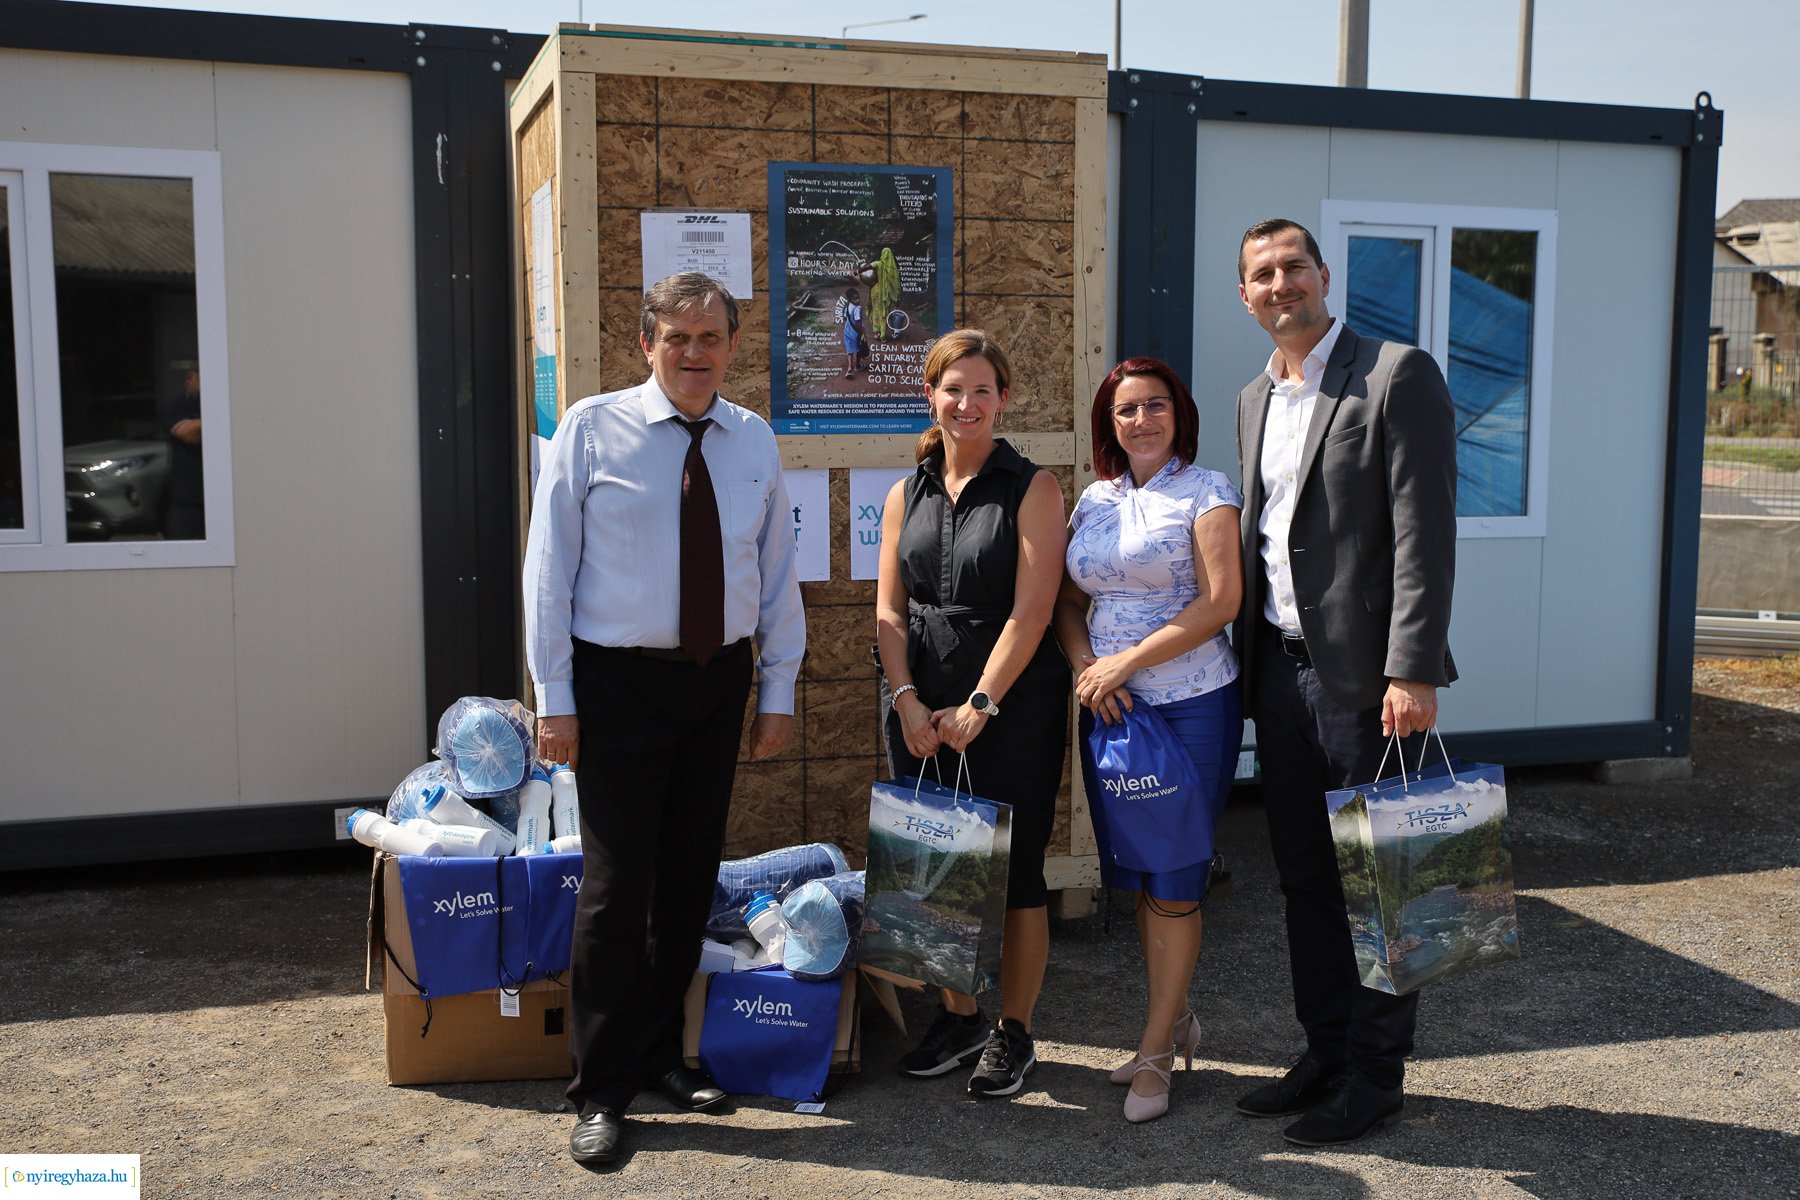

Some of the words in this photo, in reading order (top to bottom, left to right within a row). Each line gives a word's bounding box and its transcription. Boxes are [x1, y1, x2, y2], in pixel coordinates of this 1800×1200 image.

[788, 206, 832, 215] SUSTAINABLE
[836, 208, 875, 217] SOLUTIONS
[800, 259, 827, 268] HOURS
[830, 260, 837, 268] A
[838, 262, 855, 270] DAY
[790, 269, 823, 277] FETCHING
[870, 344, 898, 352] CLEAN
[902, 344, 928, 352] WATER
[884, 354, 916, 363] NEARBY,
[868, 364, 904, 374] SARITA
[907, 365, 926, 374] CAN
[868, 376, 882, 384] GO
[884, 376, 896, 384] TO
[900, 376, 925, 386] SCHO
[1102, 774, 1160, 797] xylem
[1140, 792, 1160, 800] Solve
[1160, 785, 1178, 796] Water
[1405, 802, 1468, 828] TISZA
[906, 815, 954, 840] TISZA
[1426, 822, 1448, 833] EGTC
[918, 834, 937, 844] EGTC
[432, 891, 496, 917] xylem
[460, 908, 475, 919] Let's
[476, 908, 494, 916] Solve
[732, 995, 793, 1018] xylem
[756, 1017, 771, 1026] Let's
[771, 1018, 788, 1027] Solve
[789, 1020, 808, 1028] Water
